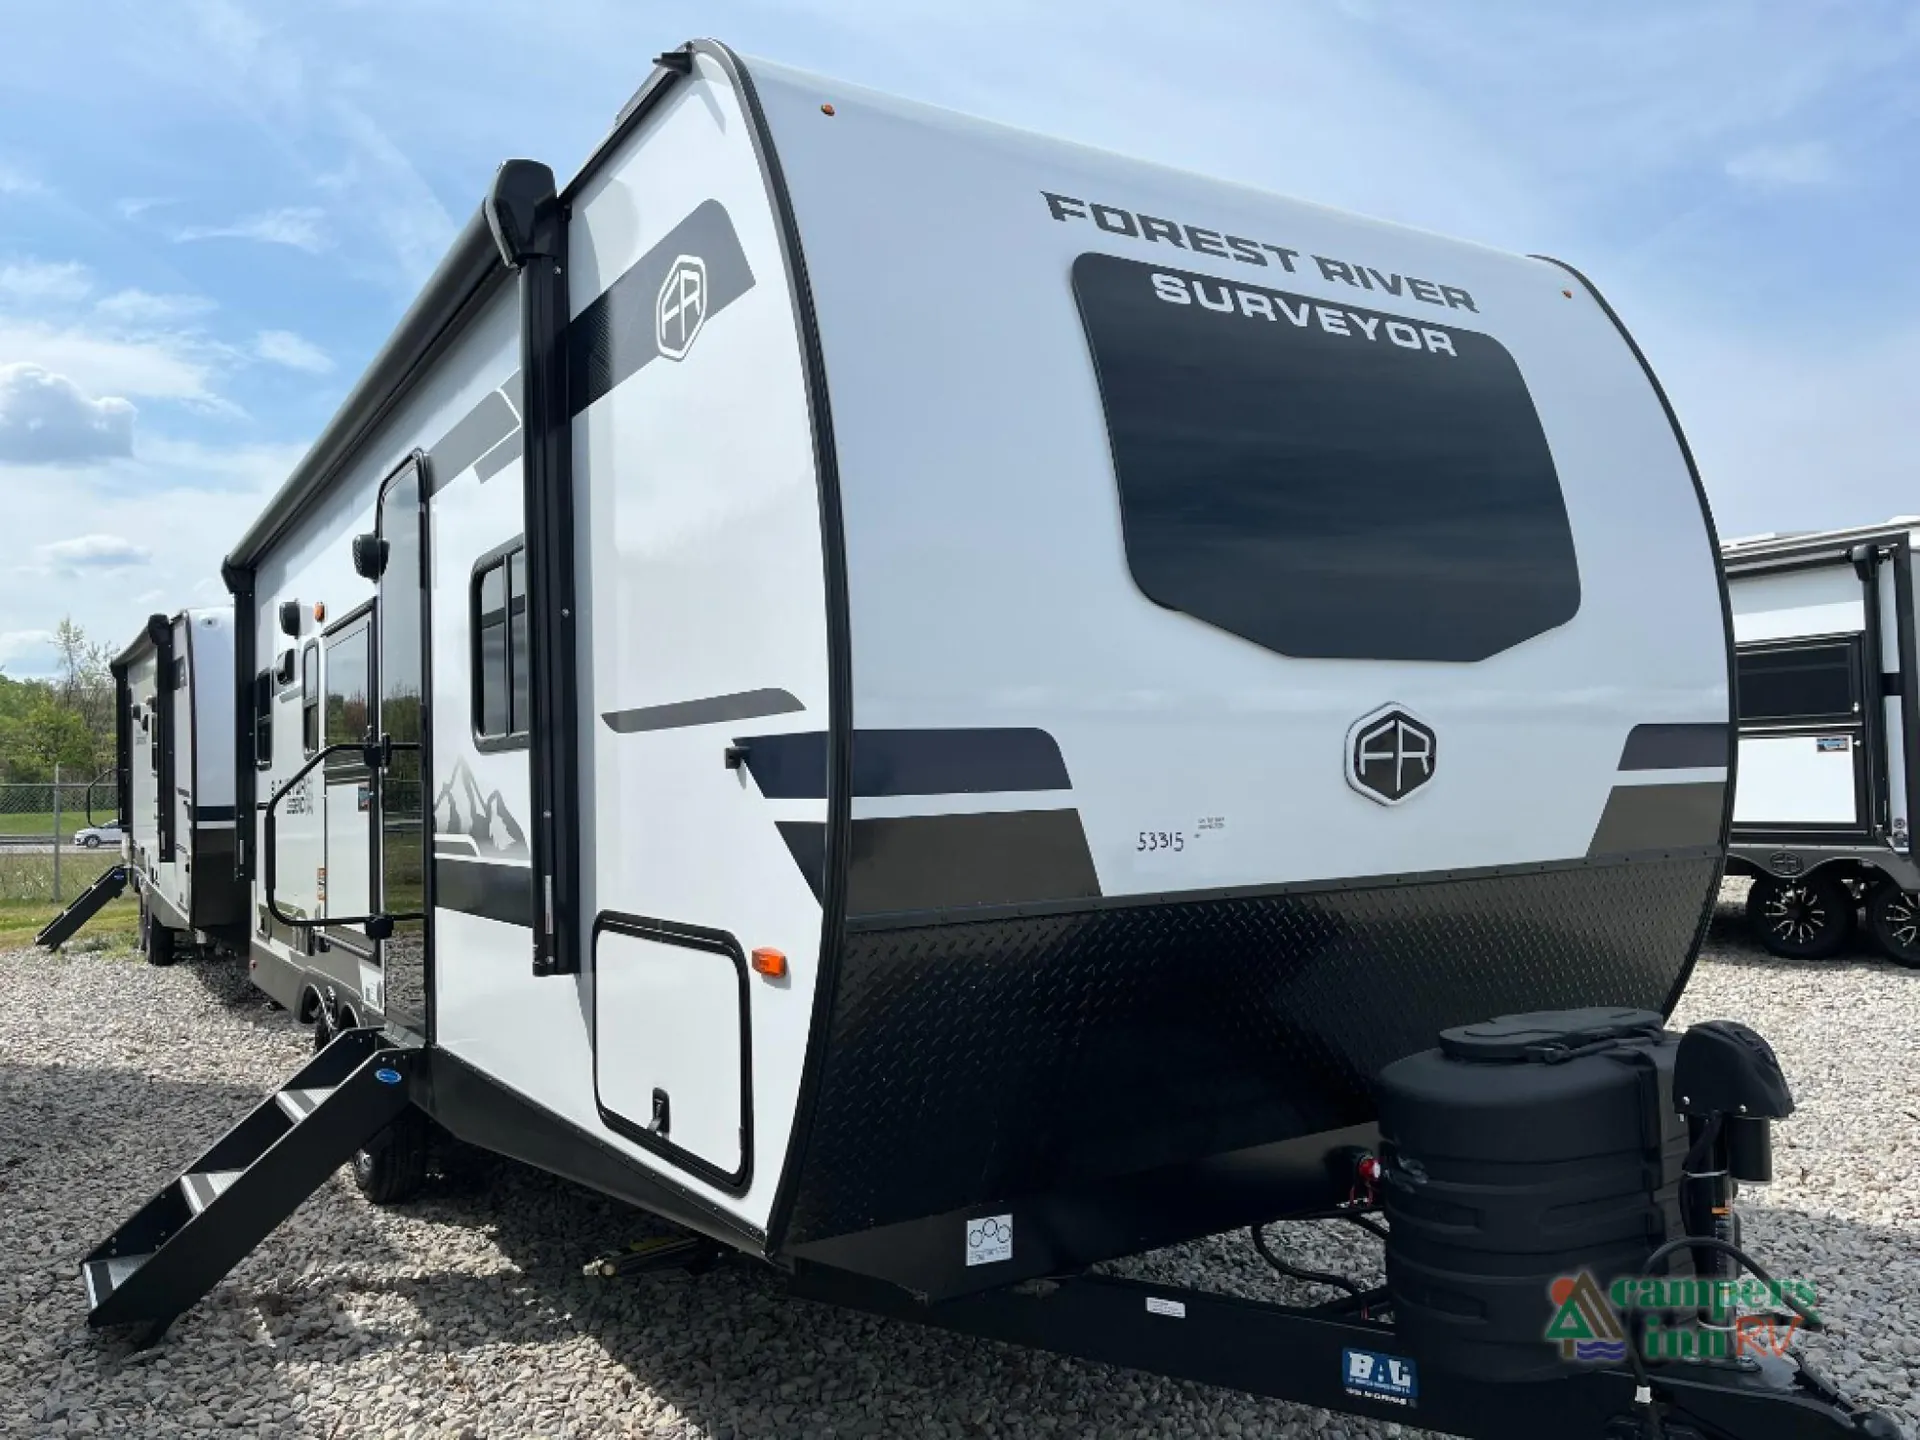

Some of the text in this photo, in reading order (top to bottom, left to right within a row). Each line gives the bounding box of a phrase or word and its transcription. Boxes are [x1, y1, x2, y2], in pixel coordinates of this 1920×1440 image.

[1039, 190, 1480, 314] FOREST RIVER
[1151, 273, 1458, 357] SURVEYOR
[1136, 831, 1184, 852] 53315
